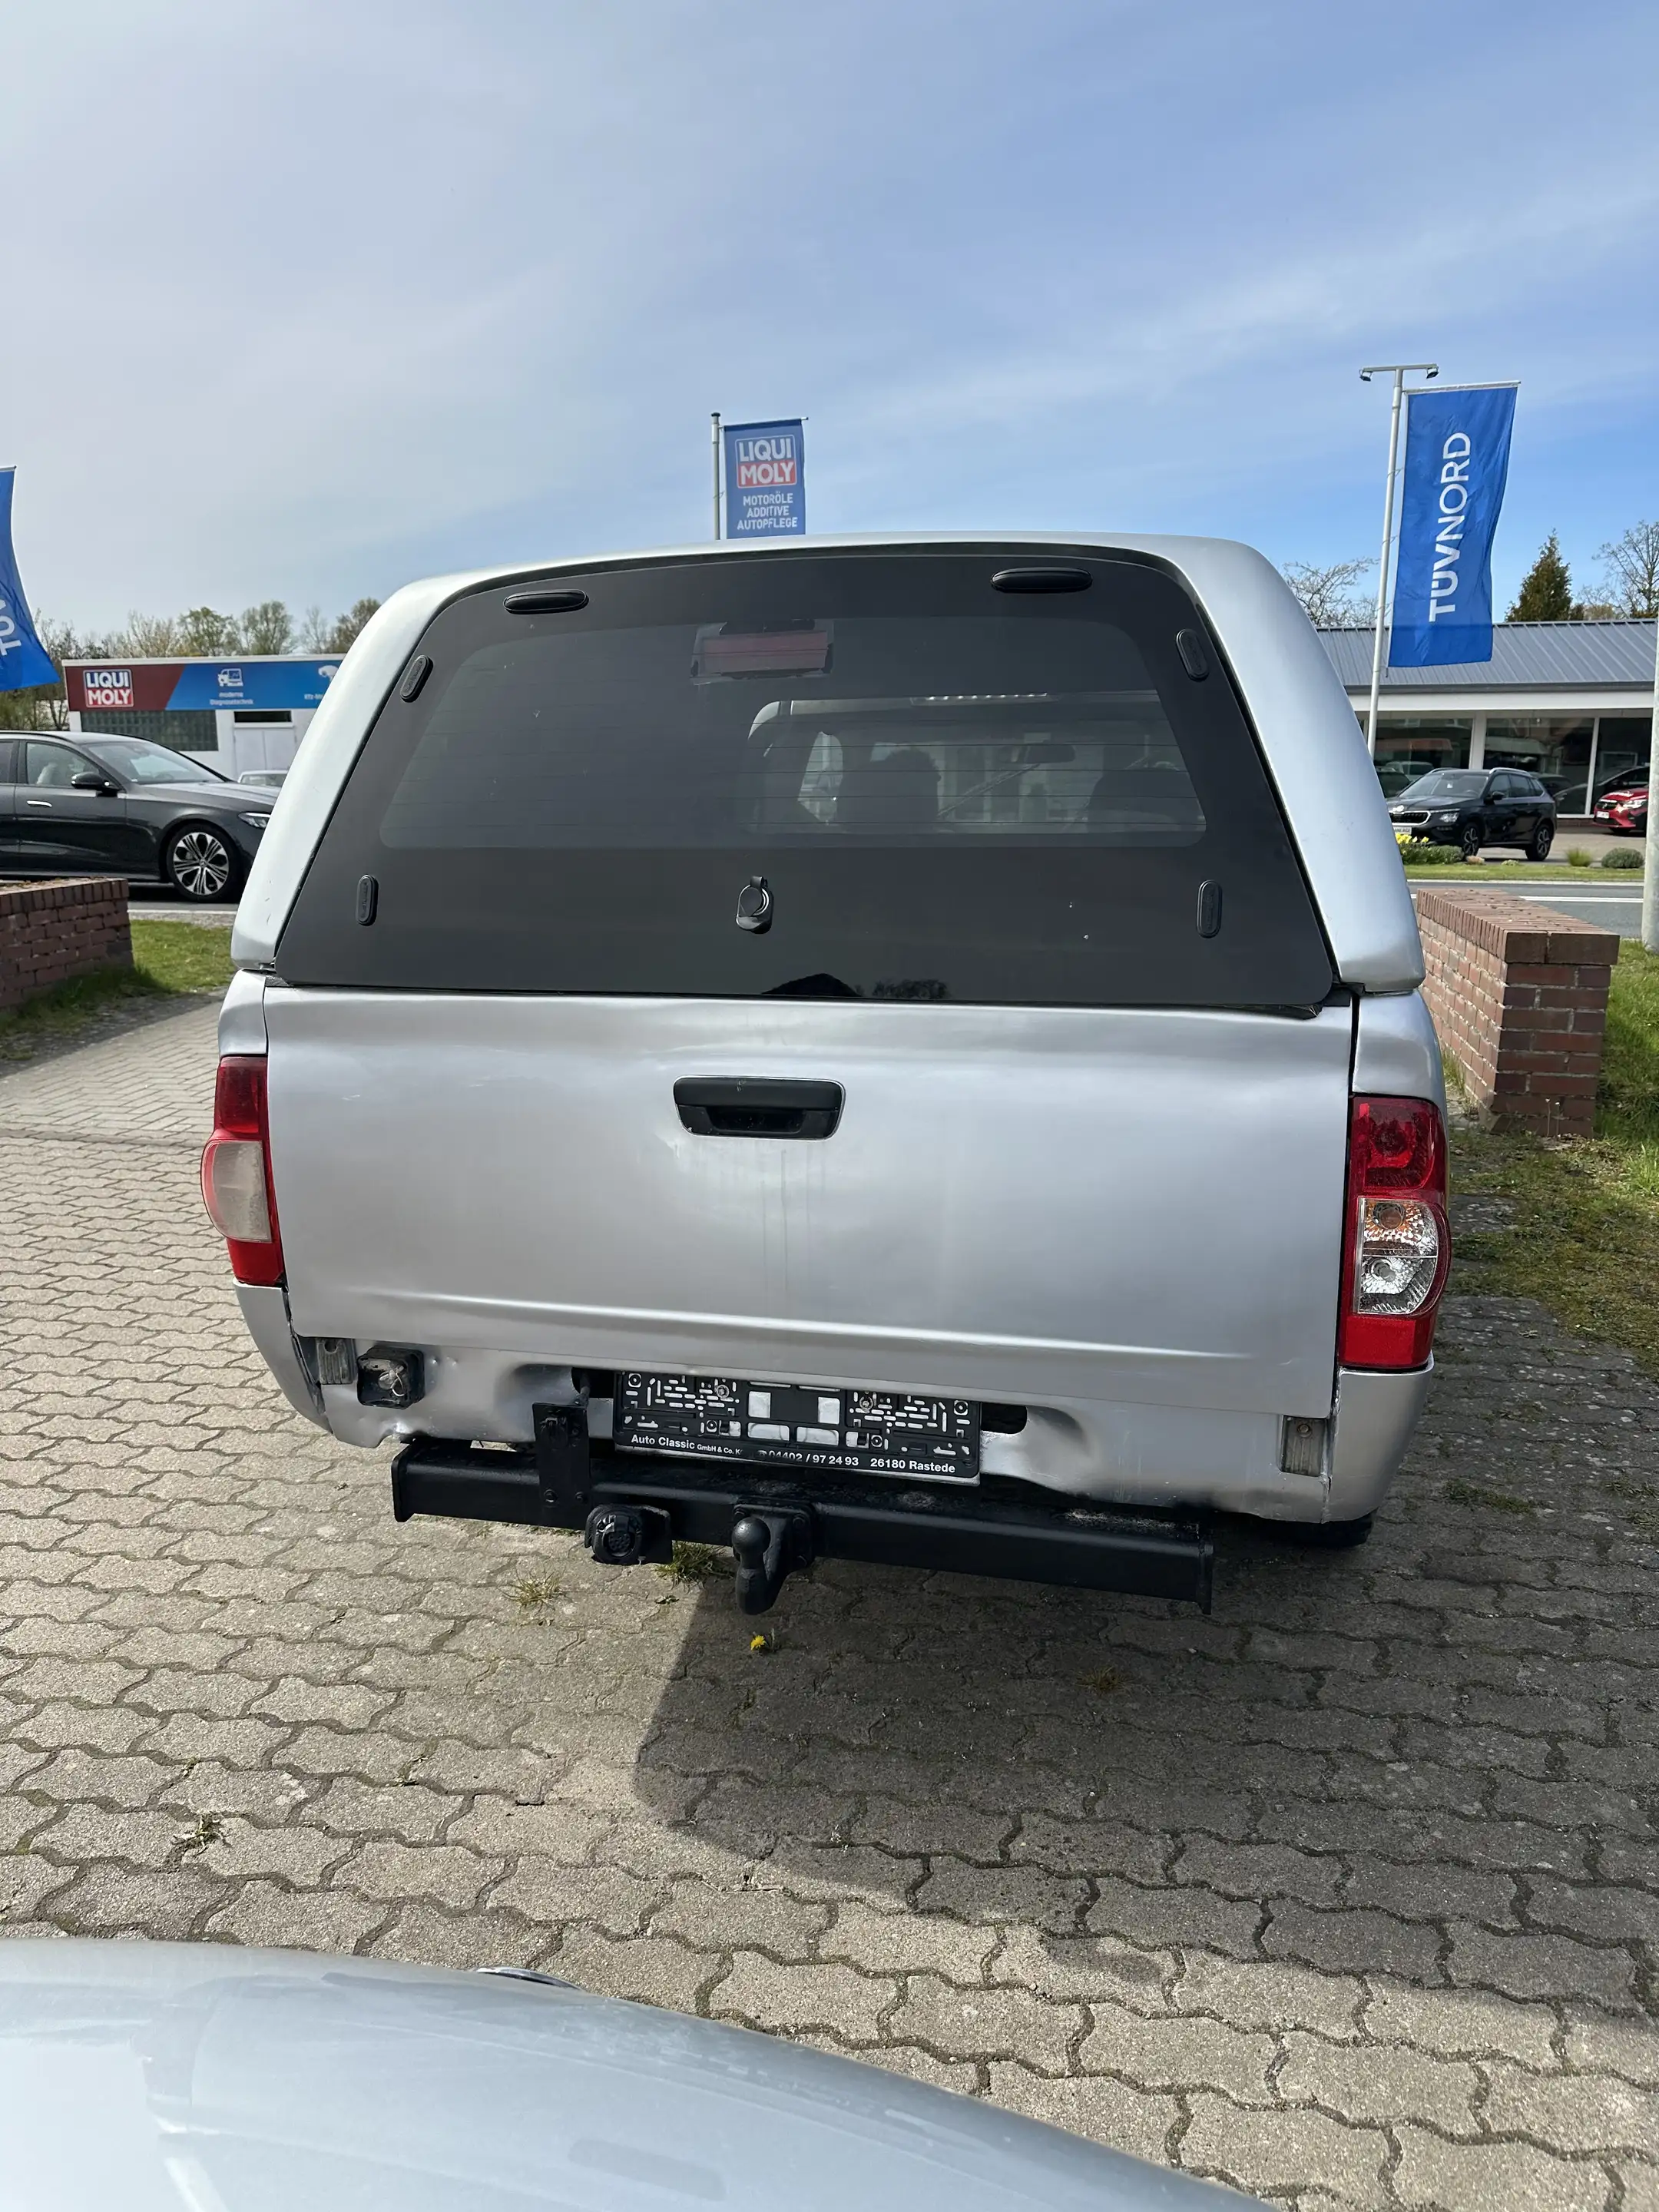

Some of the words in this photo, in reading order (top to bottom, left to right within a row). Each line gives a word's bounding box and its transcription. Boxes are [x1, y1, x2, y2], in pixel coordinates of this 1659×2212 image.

[739, 438, 792, 462] LIQUI
[740, 462, 794, 485] MOLY
[743, 491, 793, 506] MOTORÖLE
[747, 505, 790, 518] ADDITIVE
[737, 517, 798, 530] AUTOPFLEGE
[86, 671, 130, 688] LIQUI
[88, 689, 131, 705] MOLY
[631, 1434, 655, 1445] Auto
[658, 1437, 695, 1449] Classic
[697, 1444, 717, 1452] GmbH
[806, 1453, 811, 1462] /
[813, 1455, 826, 1464] 97
[828, 1455, 843, 1465] 24
[845, 1456, 859, 1466] 93
[870, 1458, 906, 1469] 26180
[909, 1460, 955, 1472] Rastede
